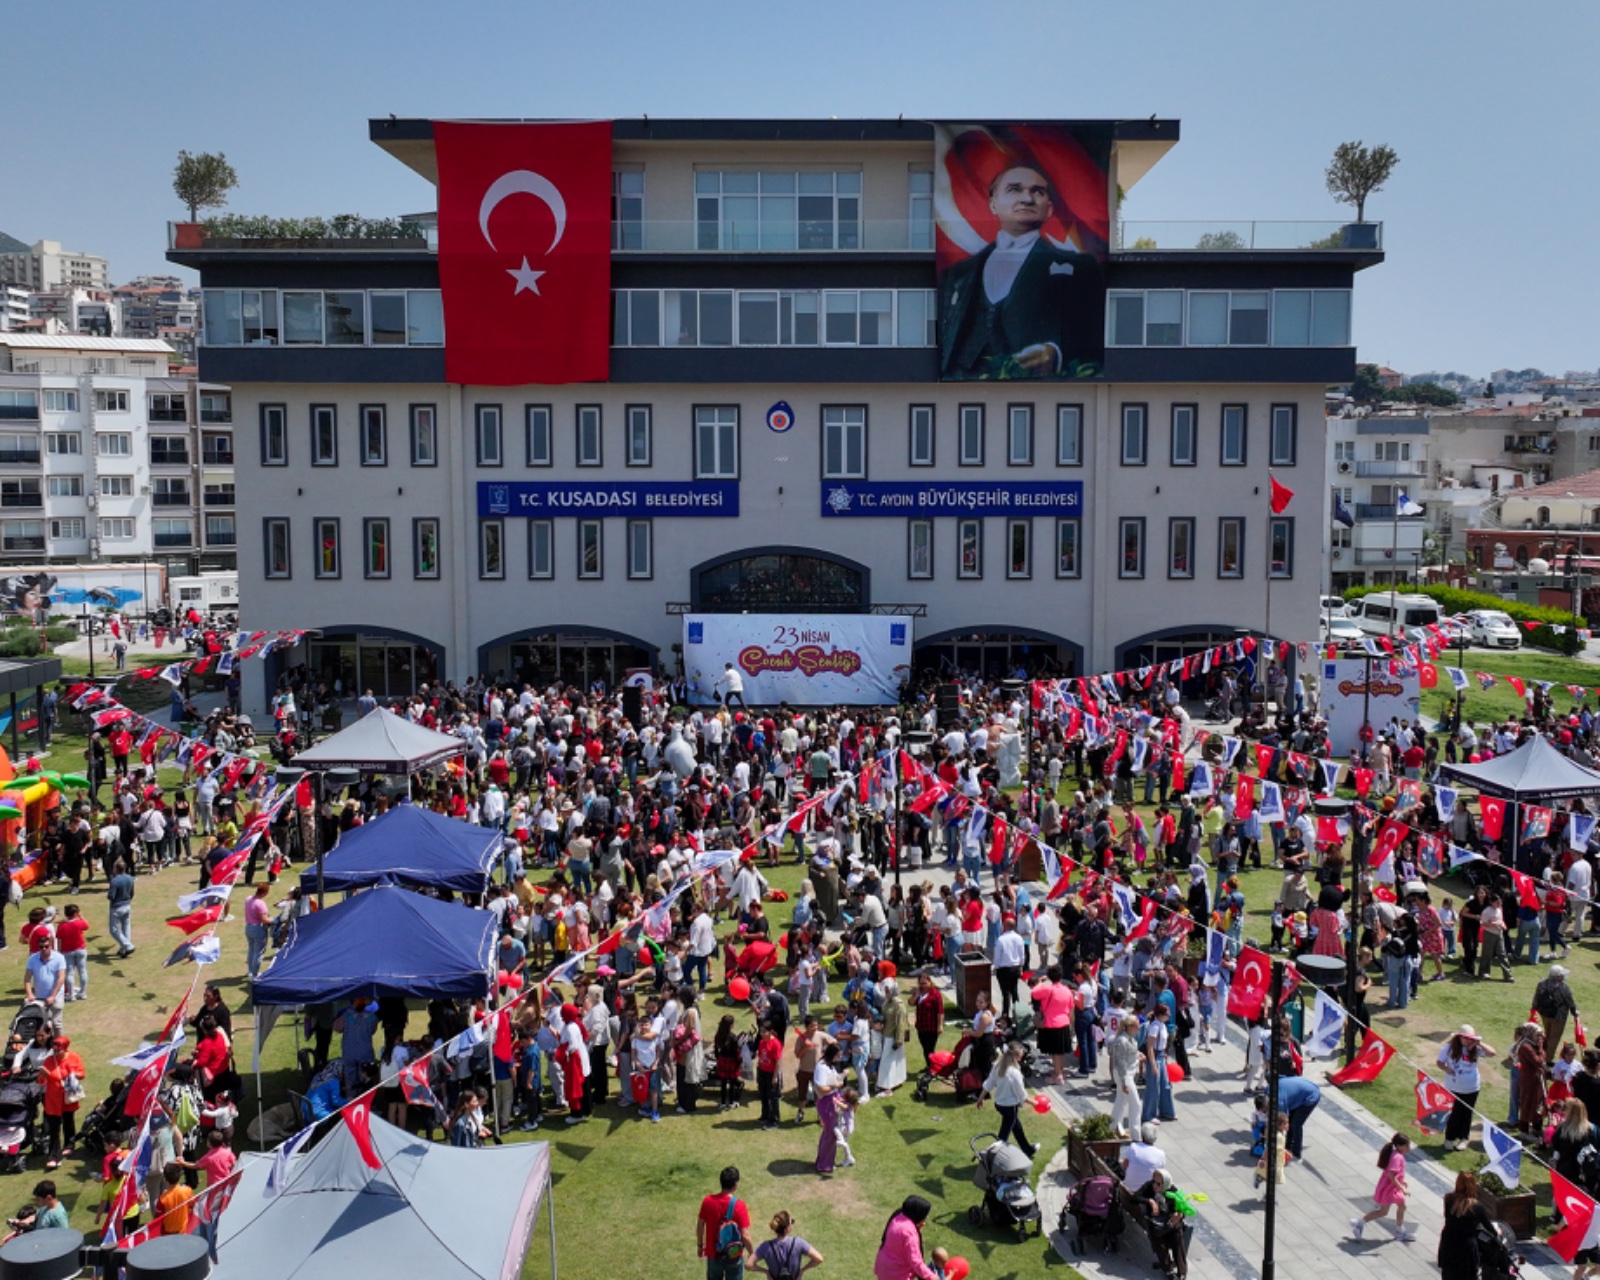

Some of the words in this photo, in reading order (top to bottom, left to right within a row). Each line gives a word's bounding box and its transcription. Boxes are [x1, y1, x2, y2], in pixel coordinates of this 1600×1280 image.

[519, 493, 543, 507] T.C.
[645, 490, 723, 507] BELEDİYESİ
[859, 493, 877, 507] T.C.
[879, 494, 914, 506] AYDIN
[918, 488, 1010, 510] BÜYÜKŞEHİR
[1014, 491, 1078, 506] BELEDİYESİ
[773, 625, 799, 647] 23
[801, 629, 830, 643] NİSAN
[742, 649, 793, 672] Çocuk
[798, 648, 857, 672] Şenliği
